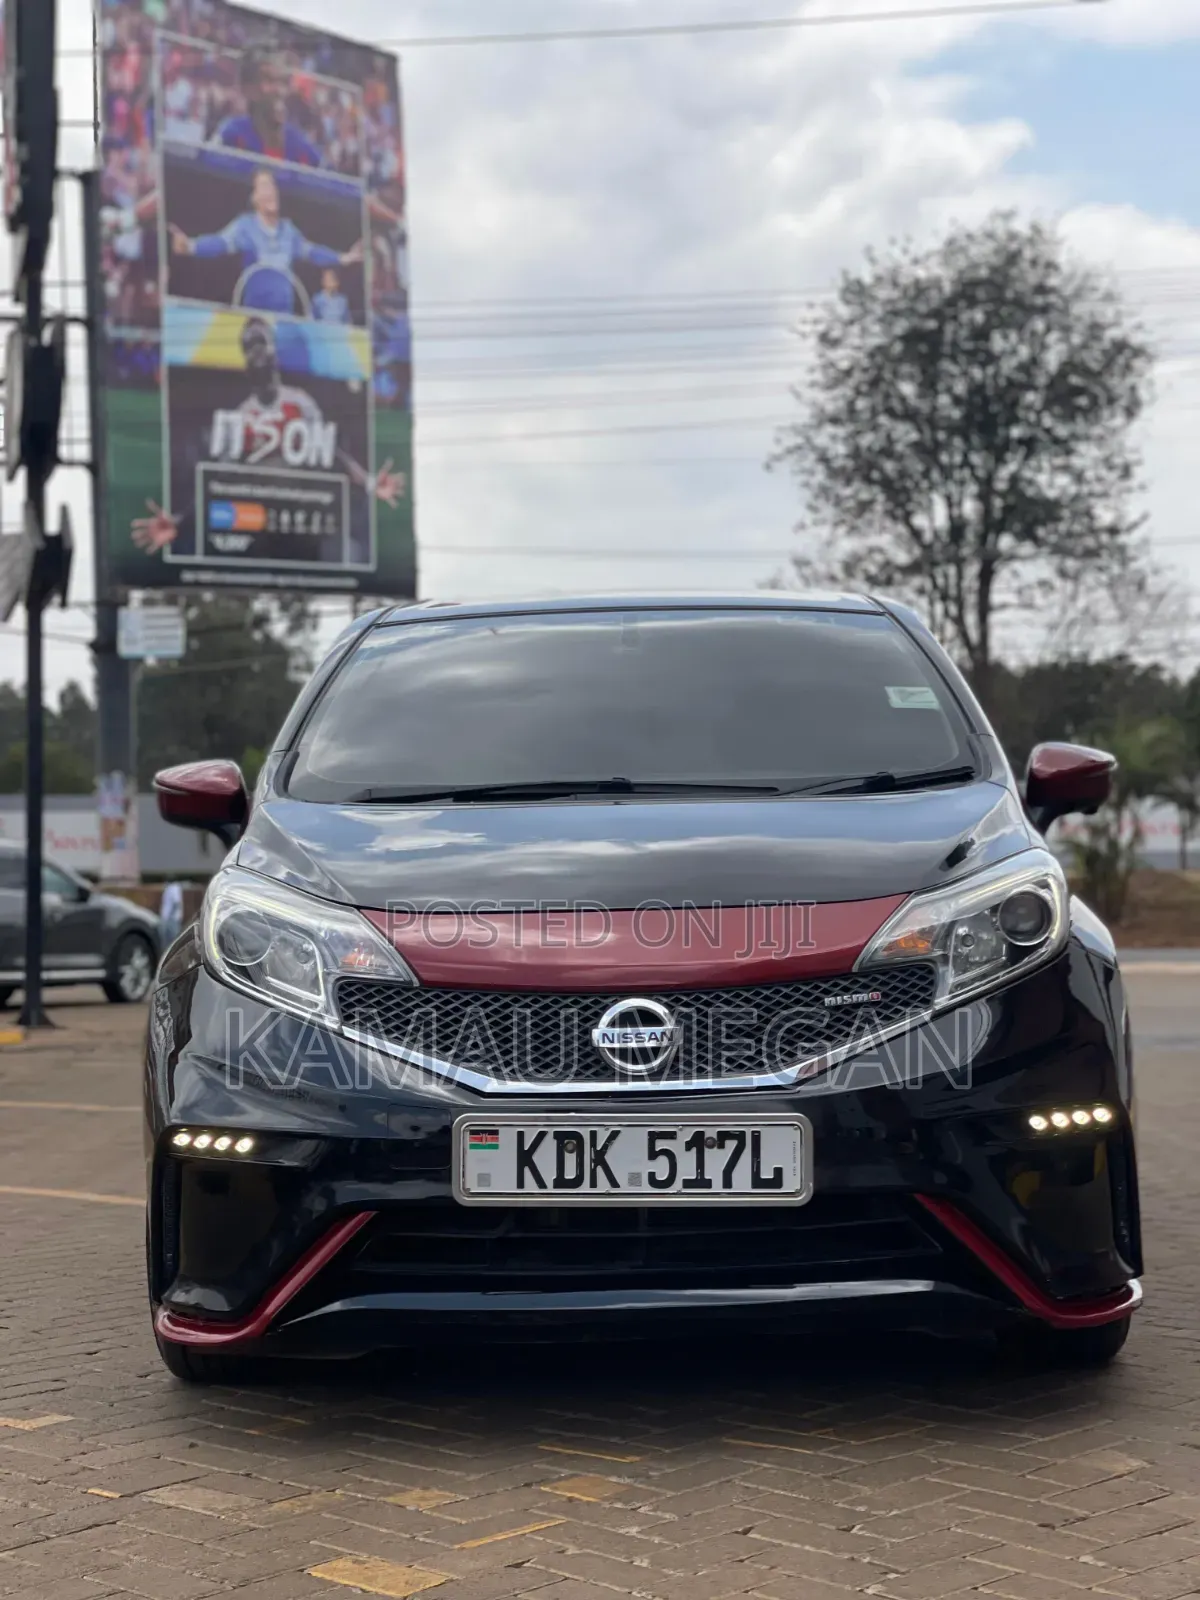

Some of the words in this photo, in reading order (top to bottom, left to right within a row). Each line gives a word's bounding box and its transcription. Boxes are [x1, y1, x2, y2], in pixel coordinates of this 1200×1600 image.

[601, 1031, 675, 1044] NISSAN
[516, 1130, 622, 1190] KDK
[647, 1130, 784, 1190] 517L
